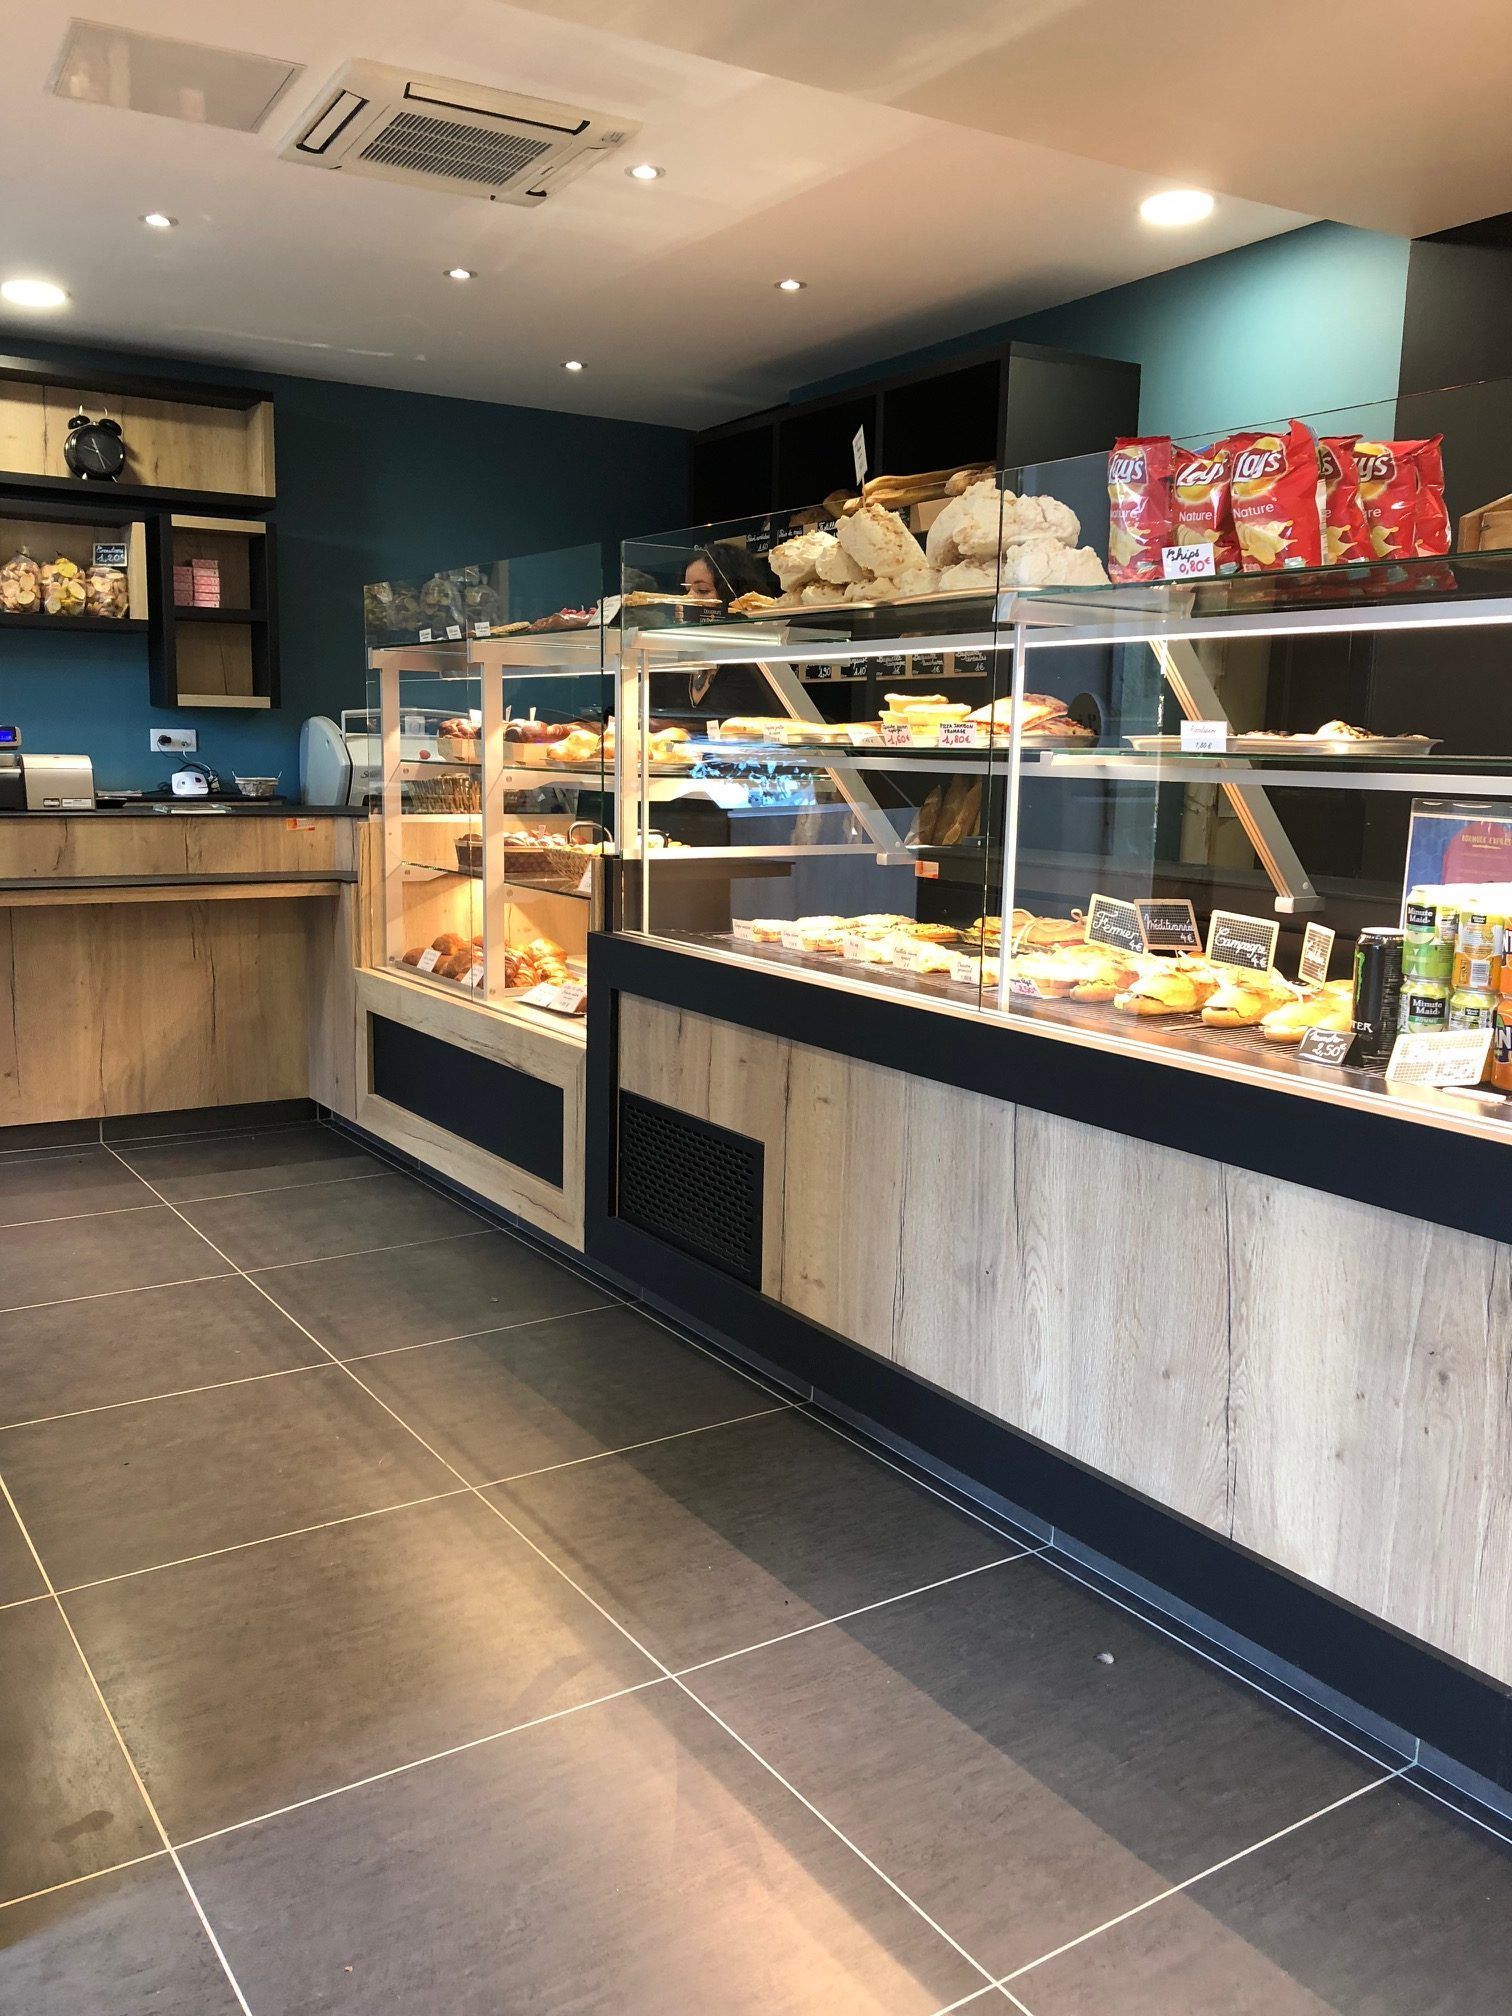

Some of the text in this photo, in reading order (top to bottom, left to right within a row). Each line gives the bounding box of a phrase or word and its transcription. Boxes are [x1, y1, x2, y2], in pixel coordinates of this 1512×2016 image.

[1111, 509, 1138, 519] ature
[1179, 511, 1213, 522] Nature
[1233, 503, 1274, 519] Nature
[1179, 557, 1210, 575] 0,80€
[942, 735, 971, 746] 1,80€
[1407, 906, 1433, 917] Minute
[1409, 914, 1428, 924] Maid
[1180, 932, 1194, 943] 4€
[1129, 940, 1143, 952] 4€
[1251, 956, 1268, 969] 4€
[1413, 998, 1442, 1008] Minute
[1415, 1006, 1439, 1016] Maid
[1312, 1043, 1348, 1057] 2,50€
